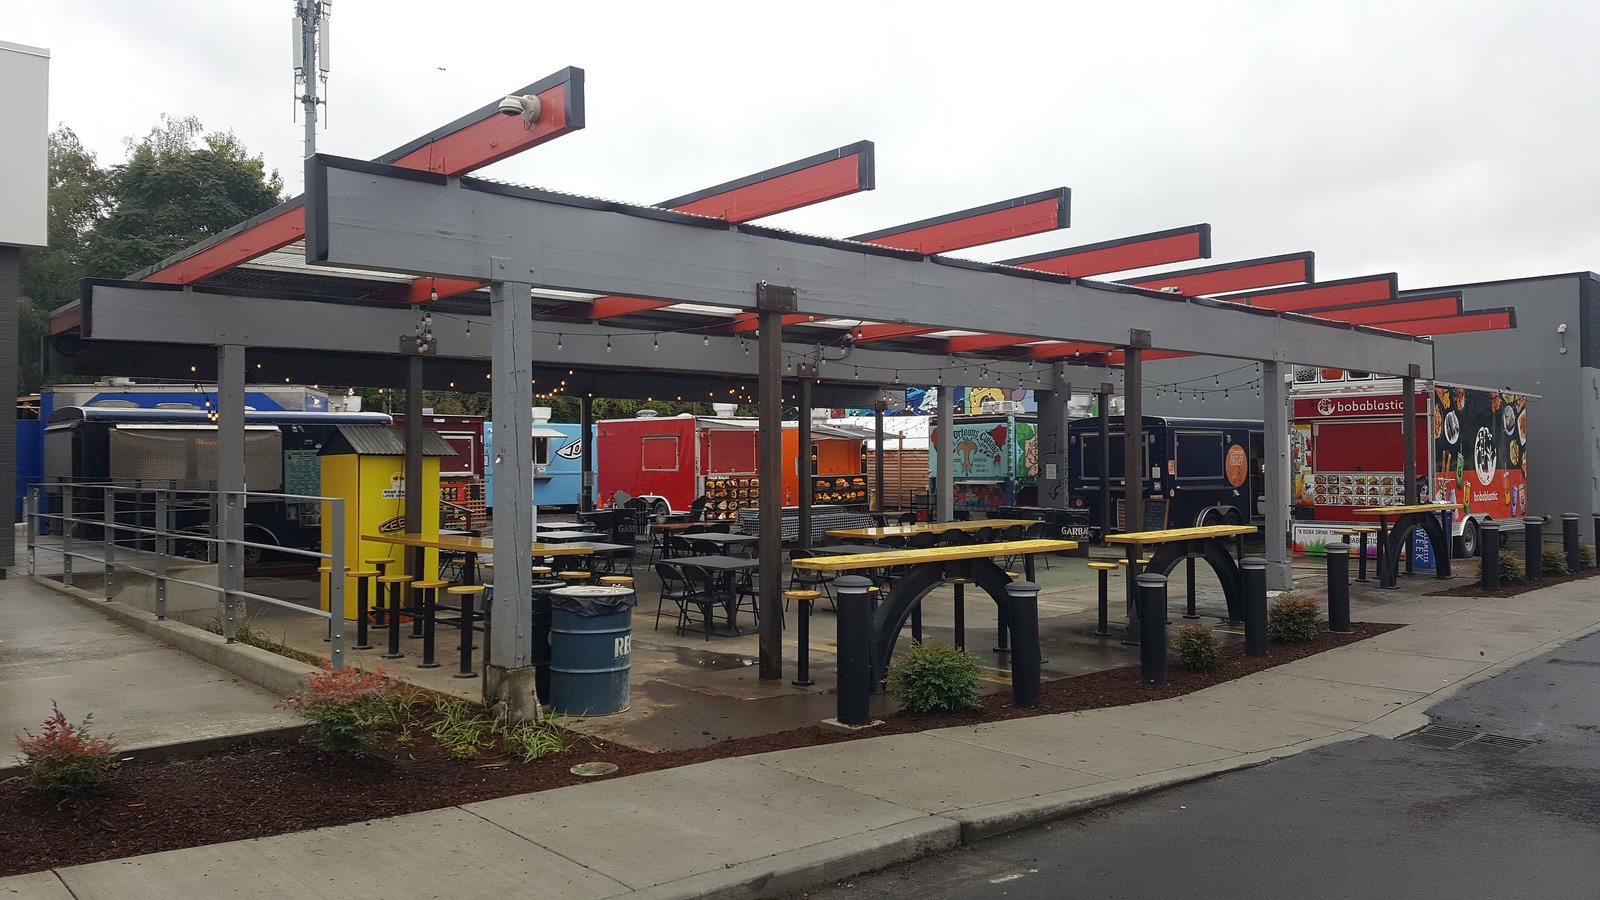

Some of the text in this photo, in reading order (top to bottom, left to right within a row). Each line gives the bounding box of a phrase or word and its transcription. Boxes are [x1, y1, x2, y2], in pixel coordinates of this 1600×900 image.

[1337, 400, 1404, 412] bobablastic
[1474, 490, 1498, 502] bobablastic
[1415, 528, 1424, 560] WEEK
